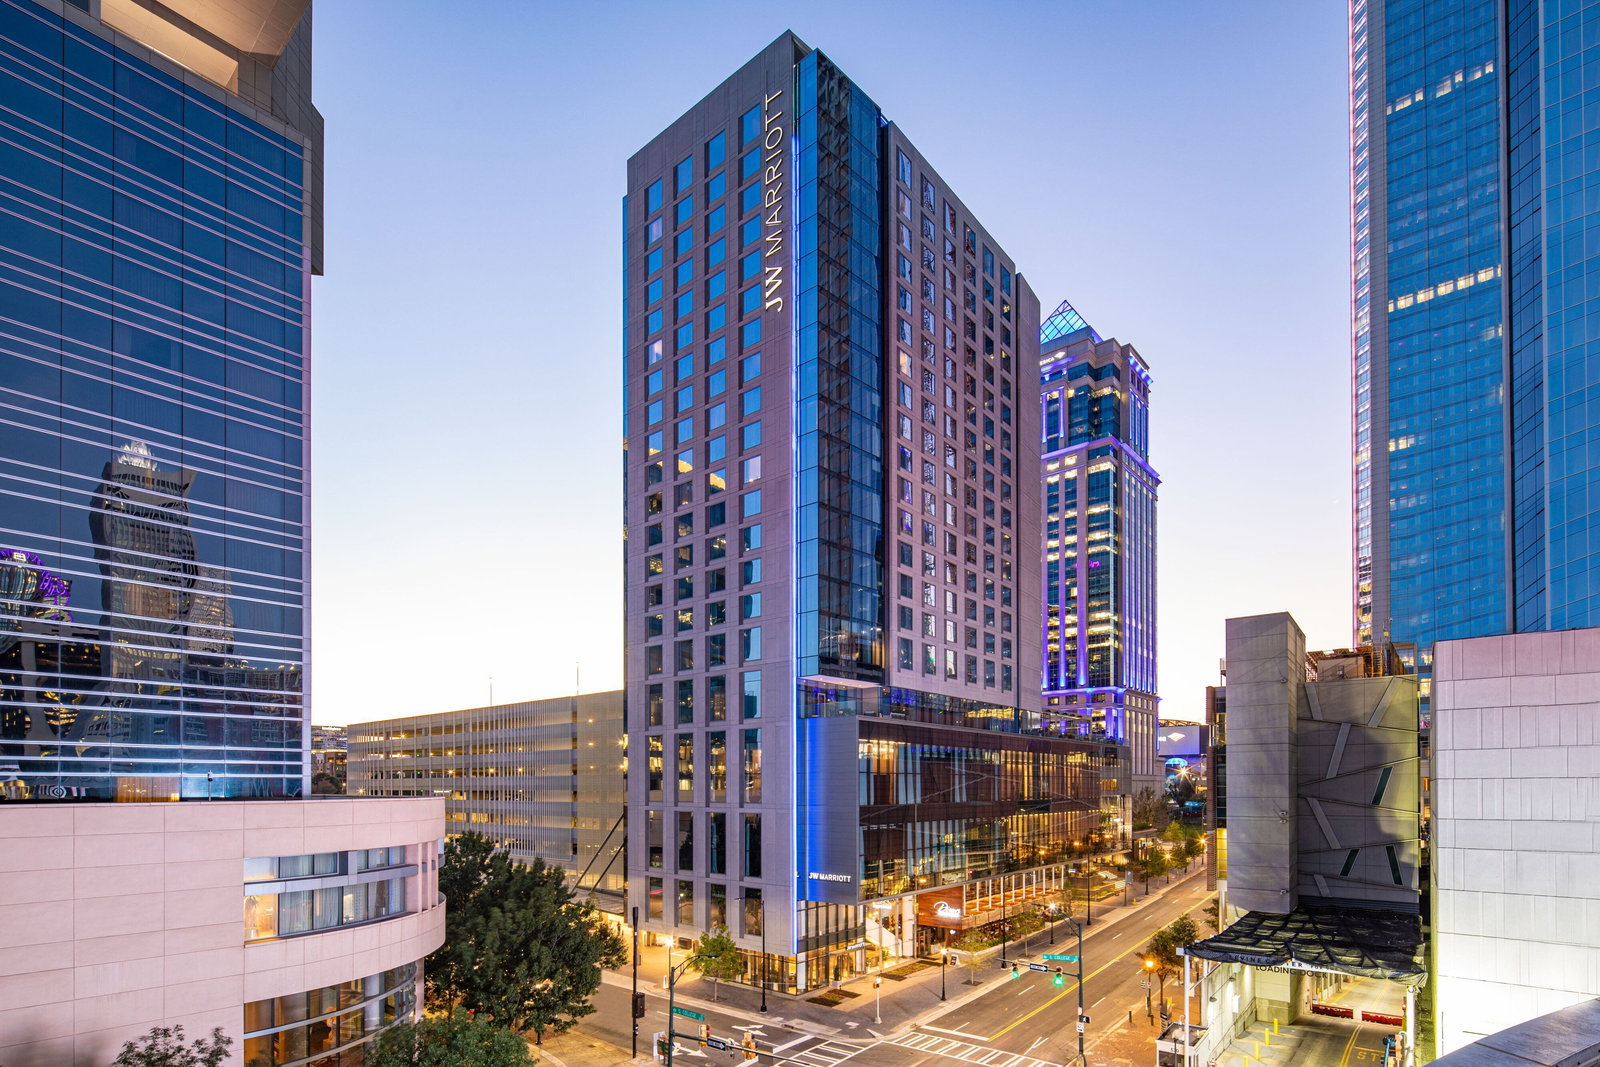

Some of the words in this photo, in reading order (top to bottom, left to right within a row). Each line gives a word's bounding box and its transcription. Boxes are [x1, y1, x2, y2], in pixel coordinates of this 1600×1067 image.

[765, 90, 783, 258] MARRIOTT
[765, 266, 783, 313] JW
[1039, 356, 1055, 367] ERICA
[808, 872, 819, 880] JW
[819, 874, 852, 882] MARRIOTT
[1255, 965, 1297, 975] LOADING
[1299, 969, 1328, 979] DOCK
